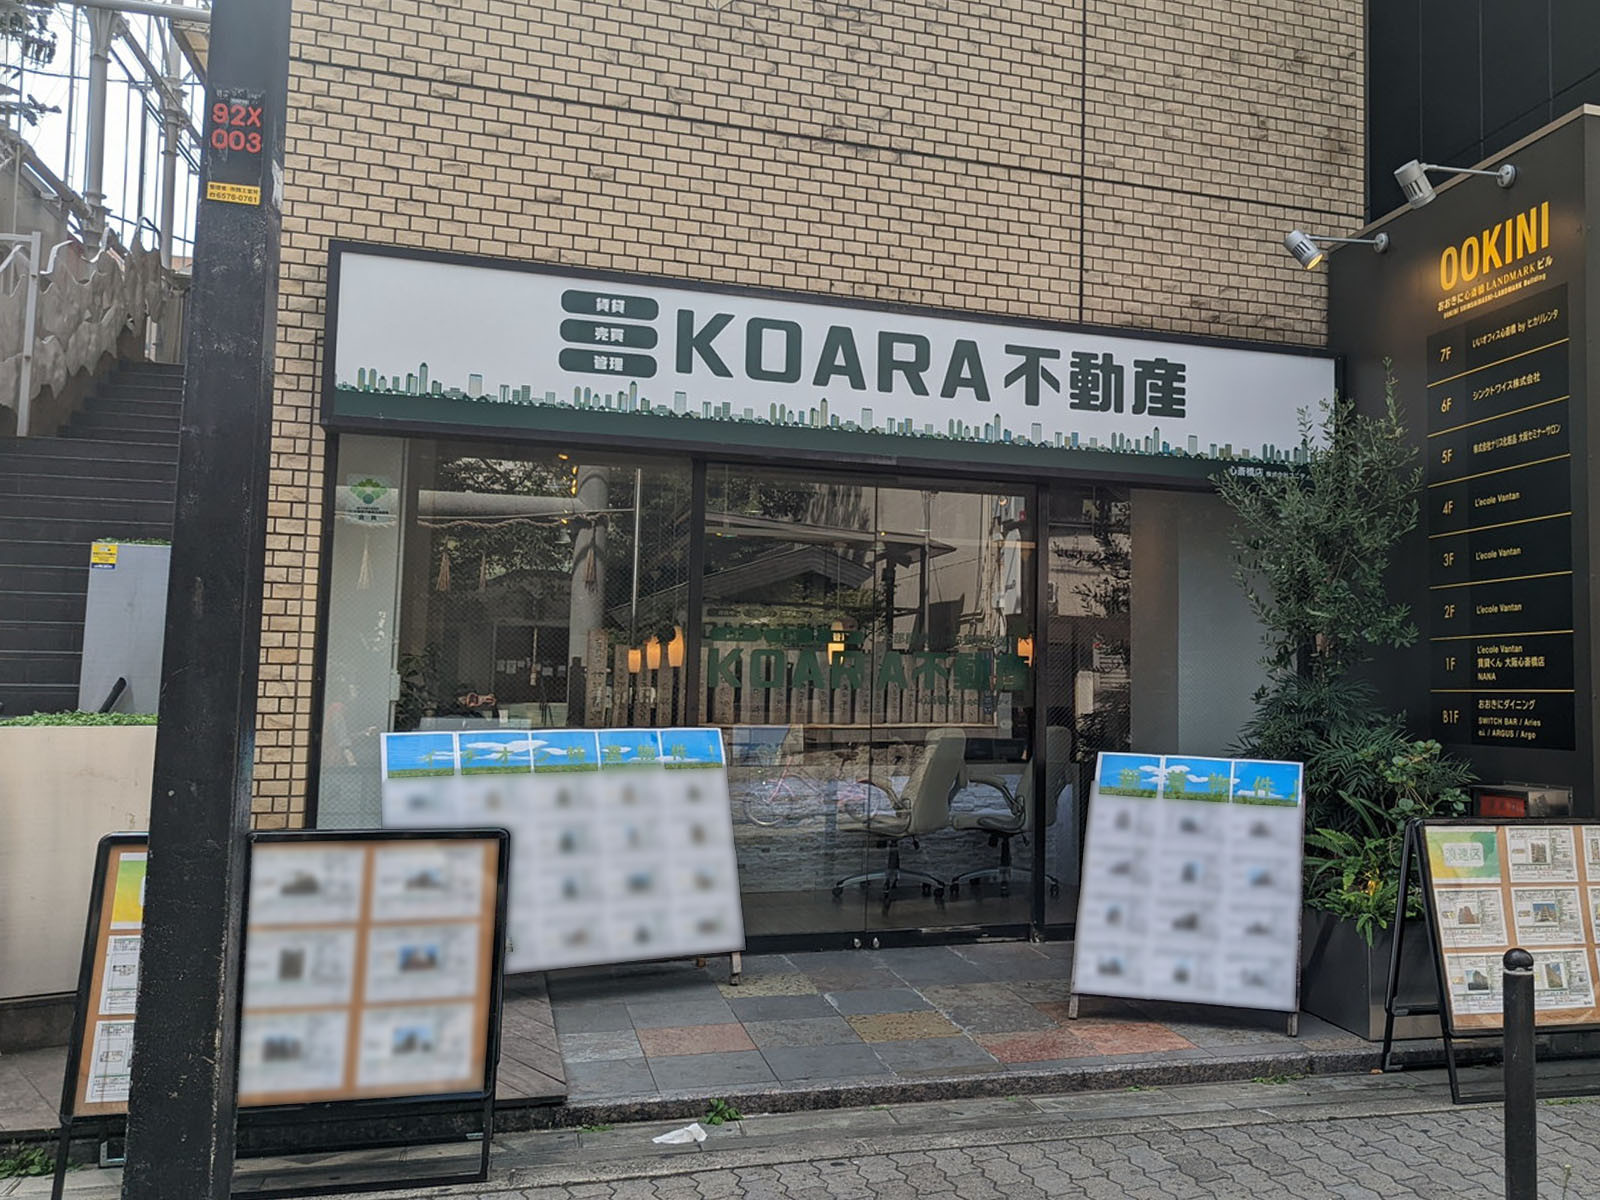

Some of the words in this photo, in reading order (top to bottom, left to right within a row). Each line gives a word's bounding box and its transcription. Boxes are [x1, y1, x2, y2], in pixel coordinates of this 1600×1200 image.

[213, 103, 262, 127] 92X
[211, 128, 262, 153] 003
[1439, 201, 1550, 291] OOKINI
[594, 326, 625, 343] 売買
[1440, 346, 1452, 362] 7F
[593, 355, 624, 372] 管理
[1441, 397, 1453, 413] 6F
[1441, 449, 1453, 464] 5F
[1442, 500, 1454, 515] 4F
[1443, 552, 1454, 567] 3F
[1444, 604, 1455, 619] 2F
[1445, 657, 1456, 671] 1F
[1478, 699, 1536, 710] おおきにダイニング
[1442, 710, 1459, 724] B1F
[1504, 717, 1518, 726] BAR
